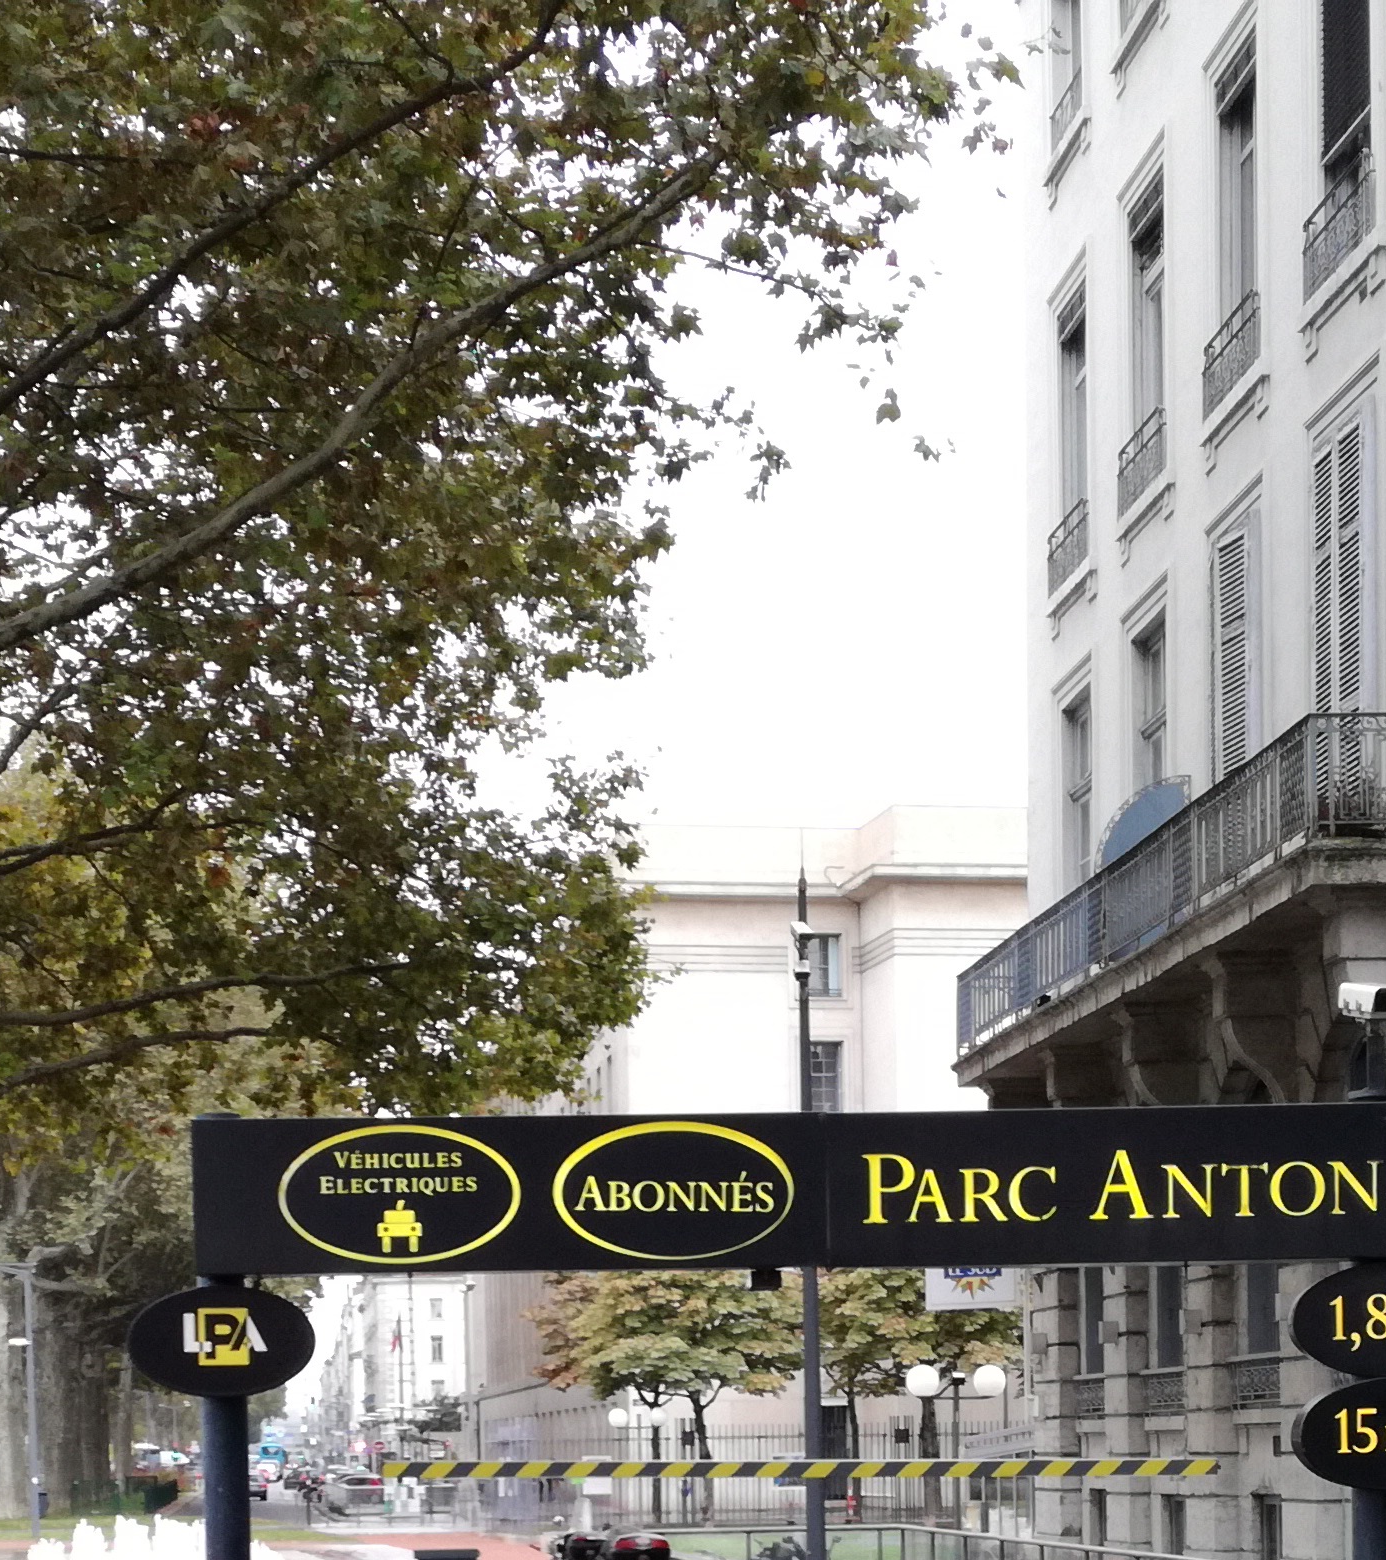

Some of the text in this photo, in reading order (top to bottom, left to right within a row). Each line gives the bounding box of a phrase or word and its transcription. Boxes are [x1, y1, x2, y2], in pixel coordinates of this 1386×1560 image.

[333, 1150, 463, 1169] VÉHICULES
[319, 1175, 478, 1196] ELECTRIQUES
[573, 1170, 775, 1212] ABONNÉS
[862, 1153, 1056, 1223] PARC
[183, 1312, 269, 1360] LPA
[1334, 1407, 1379, 1454] 15
